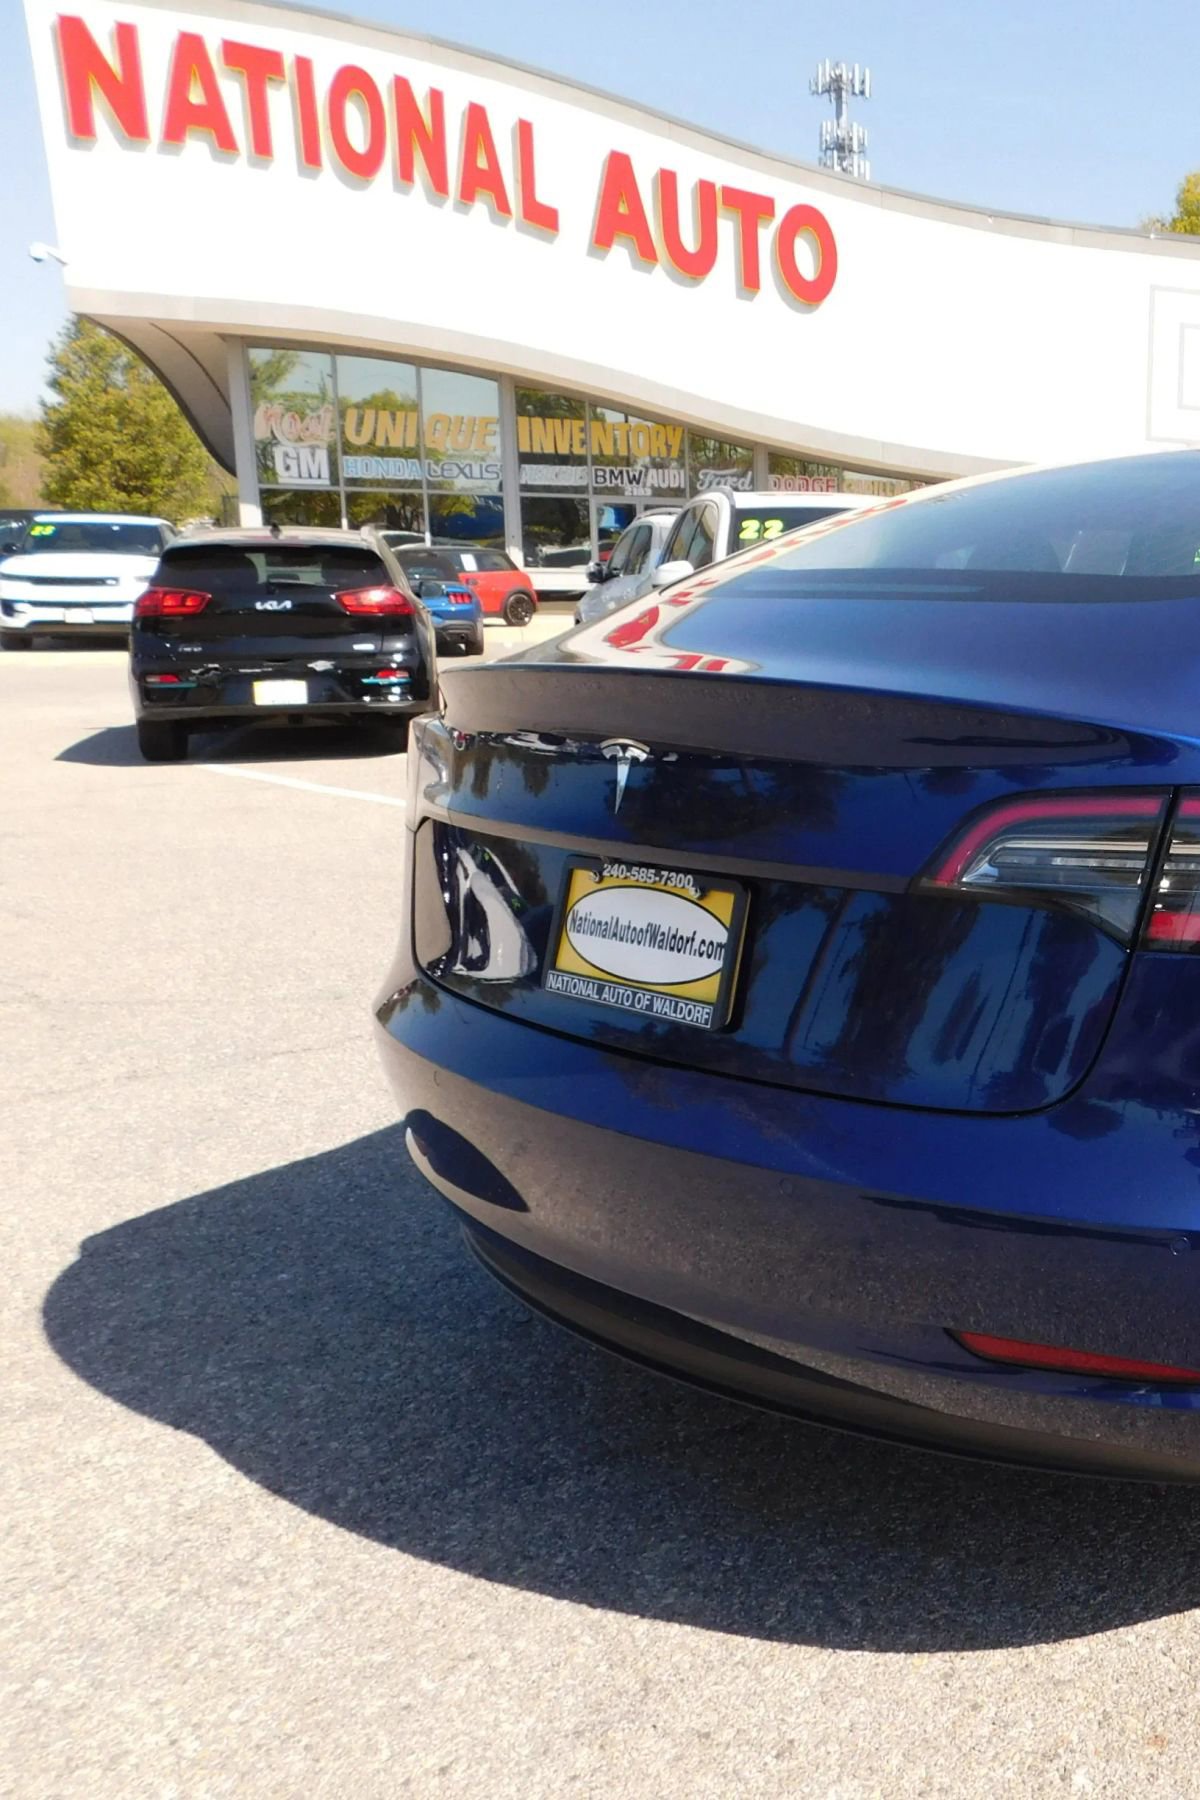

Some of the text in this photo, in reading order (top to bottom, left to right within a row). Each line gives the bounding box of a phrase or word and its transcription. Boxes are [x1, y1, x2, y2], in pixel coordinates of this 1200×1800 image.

[56, 14, 839, 307] NATIONAL AUTO
[344, 408, 498, 452] UNIQUE
[517, 416, 684, 459] INVENTORY
[274, 447, 330, 484] GM
[343, 456, 423, 480] HONDA
[425, 460, 501, 482] LEXUS
[593, 466, 644, 487] BMW
[645, 468, 685, 489] AUDI
[697, 469, 753, 491] Ford
[768, 473, 838, 492] DODGE
[738, 519, 785, 540] 22
[602, 863, 694, 889] 240-585-7300
[568, 908, 726, 962] NationalAutoofWaldorf.com
[548, 973, 711, 1024] NATIONAL AUTO OF WALDORF
